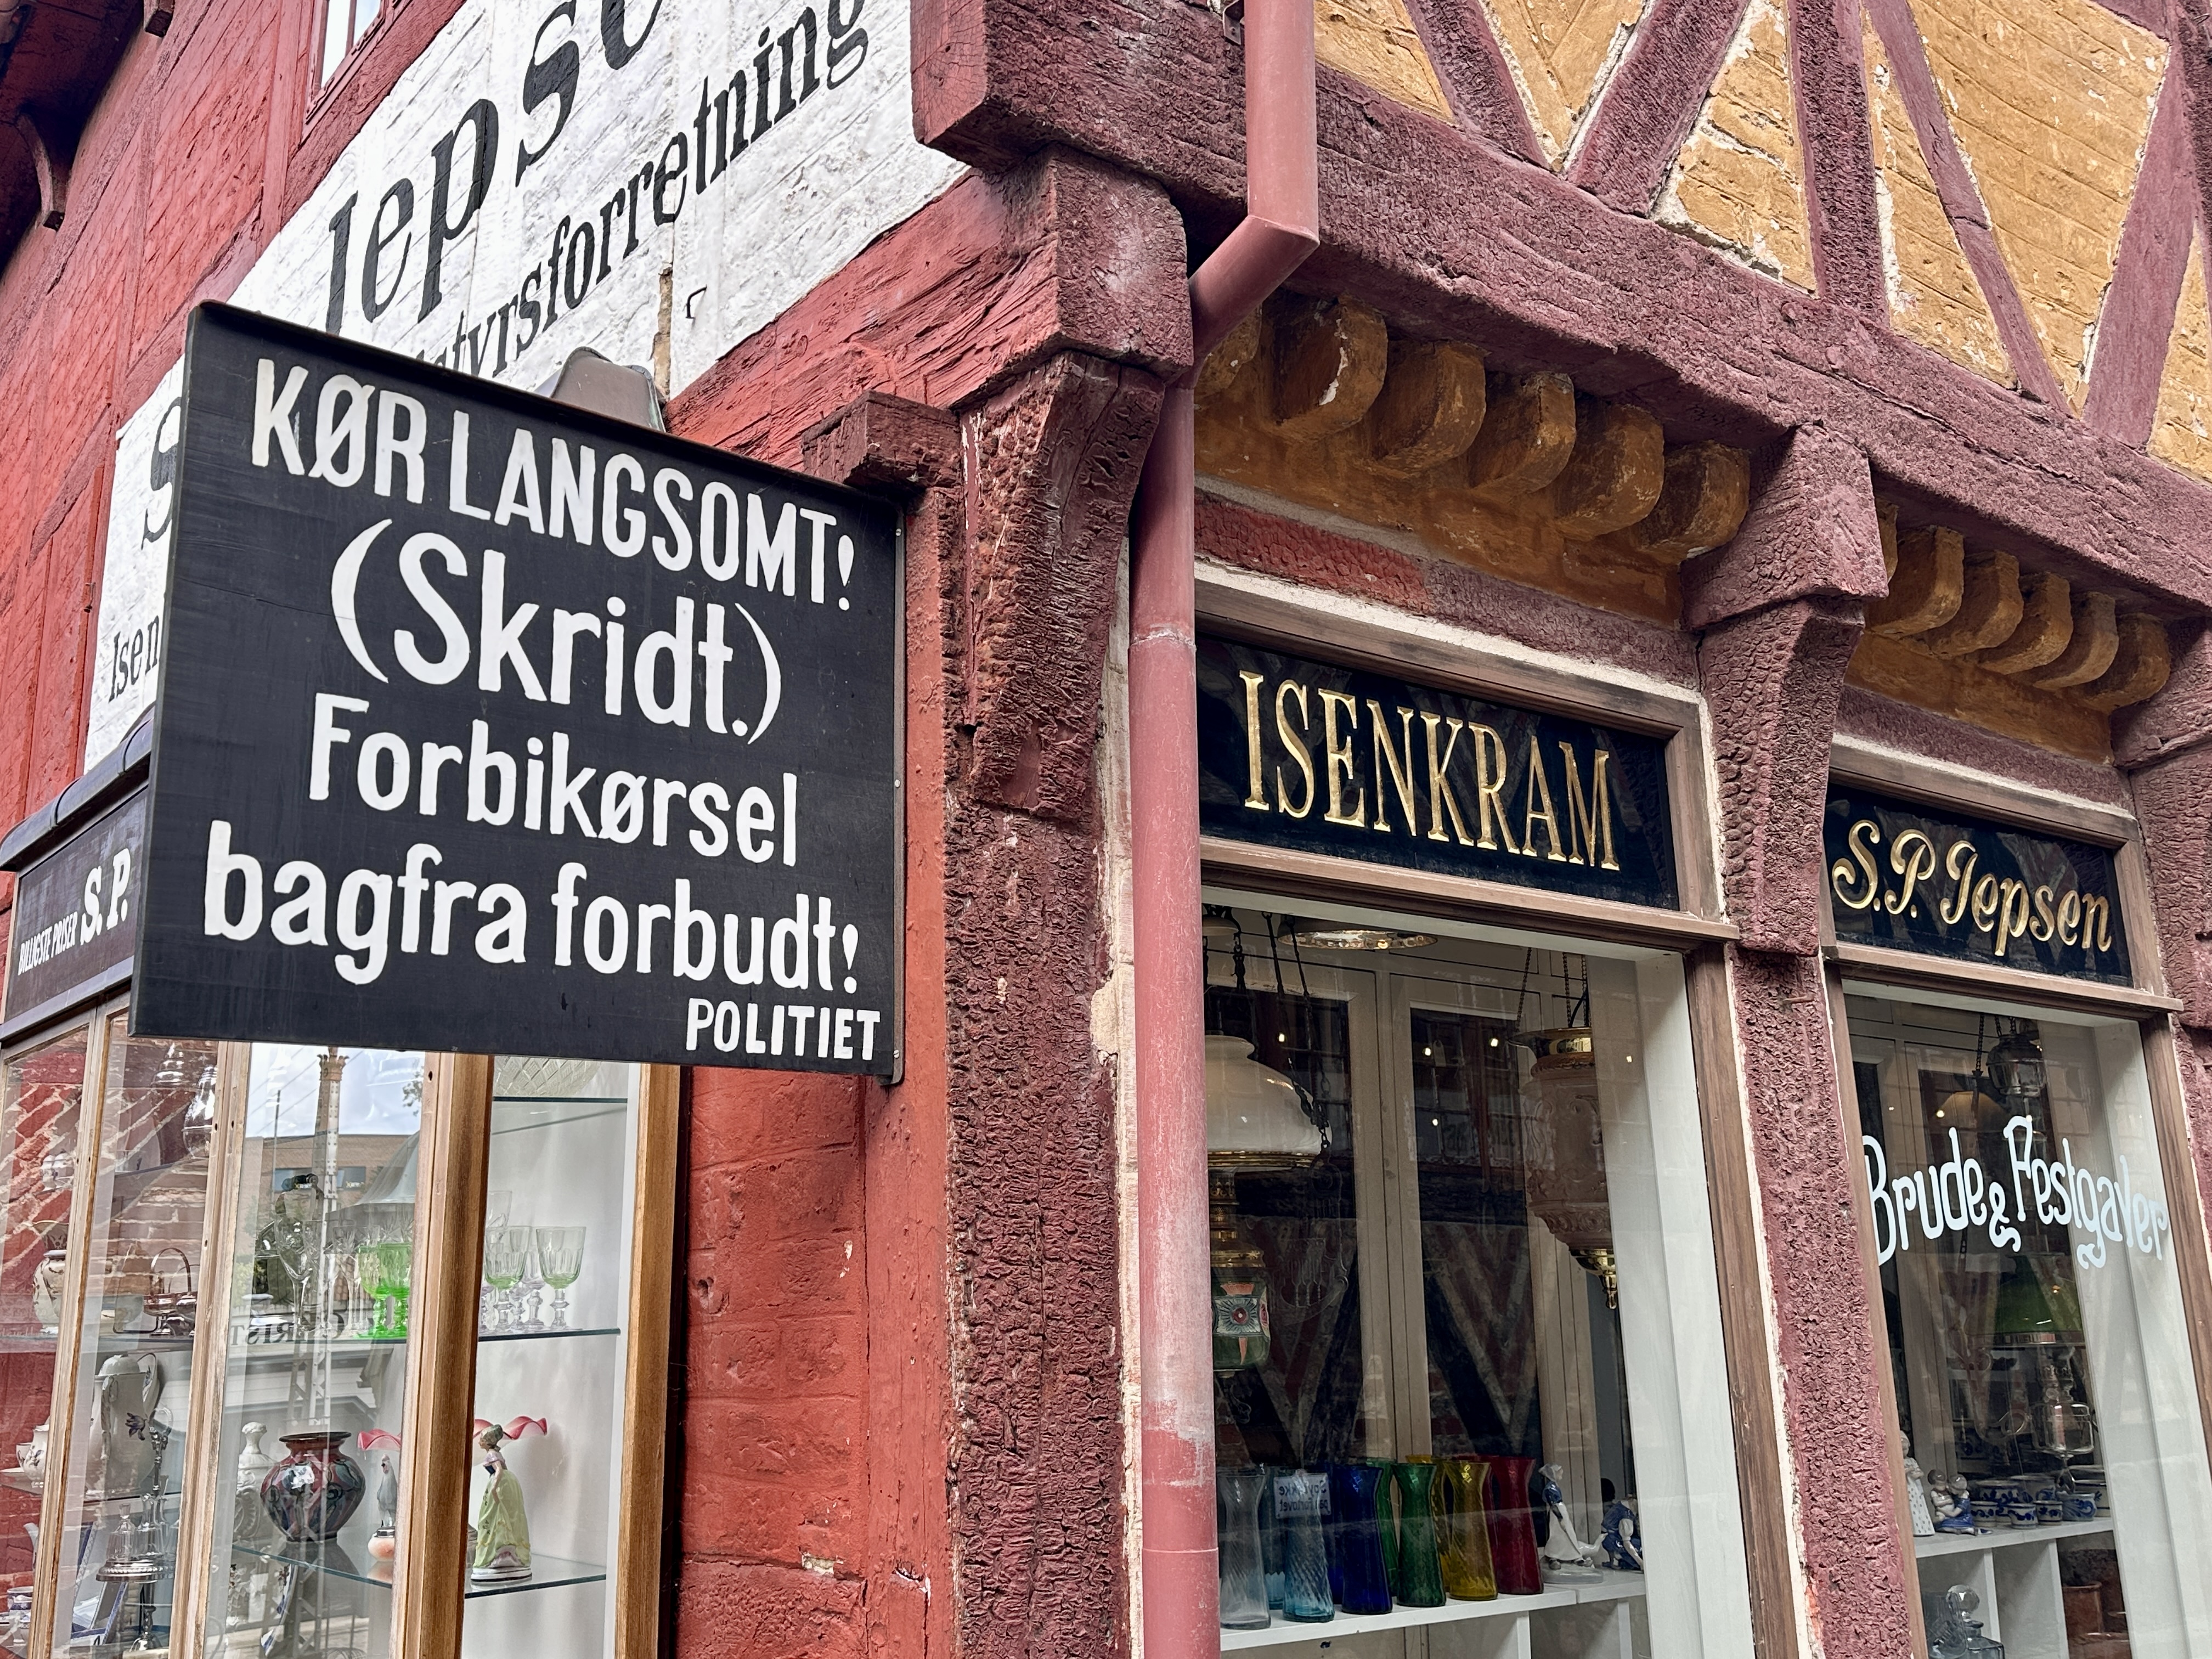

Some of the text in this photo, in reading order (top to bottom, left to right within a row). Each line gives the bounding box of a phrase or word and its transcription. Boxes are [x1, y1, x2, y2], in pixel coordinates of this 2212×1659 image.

[252, 359, 854, 610] KØR LANGSOMT!
[109, 591, 165, 703] Isen
[331, 519, 781, 744] (Skridt.)
[309, 693, 797, 866] Forbikørsel
[1239, 670, 1621, 871] ISENKRAM
[18, 926, 53, 975] BILLIGSTE
[50, 911, 78, 958] PRISER
[205, 820, 859, 993] bagfra forbudt!
[1940, 840, 2112, 956] Jepsen
[686, 998, 880, 1060] POLITIET
[1862, 1127, 1987, 1266] Brude
[2003, 1115, 2169, 1269] Festgaver
